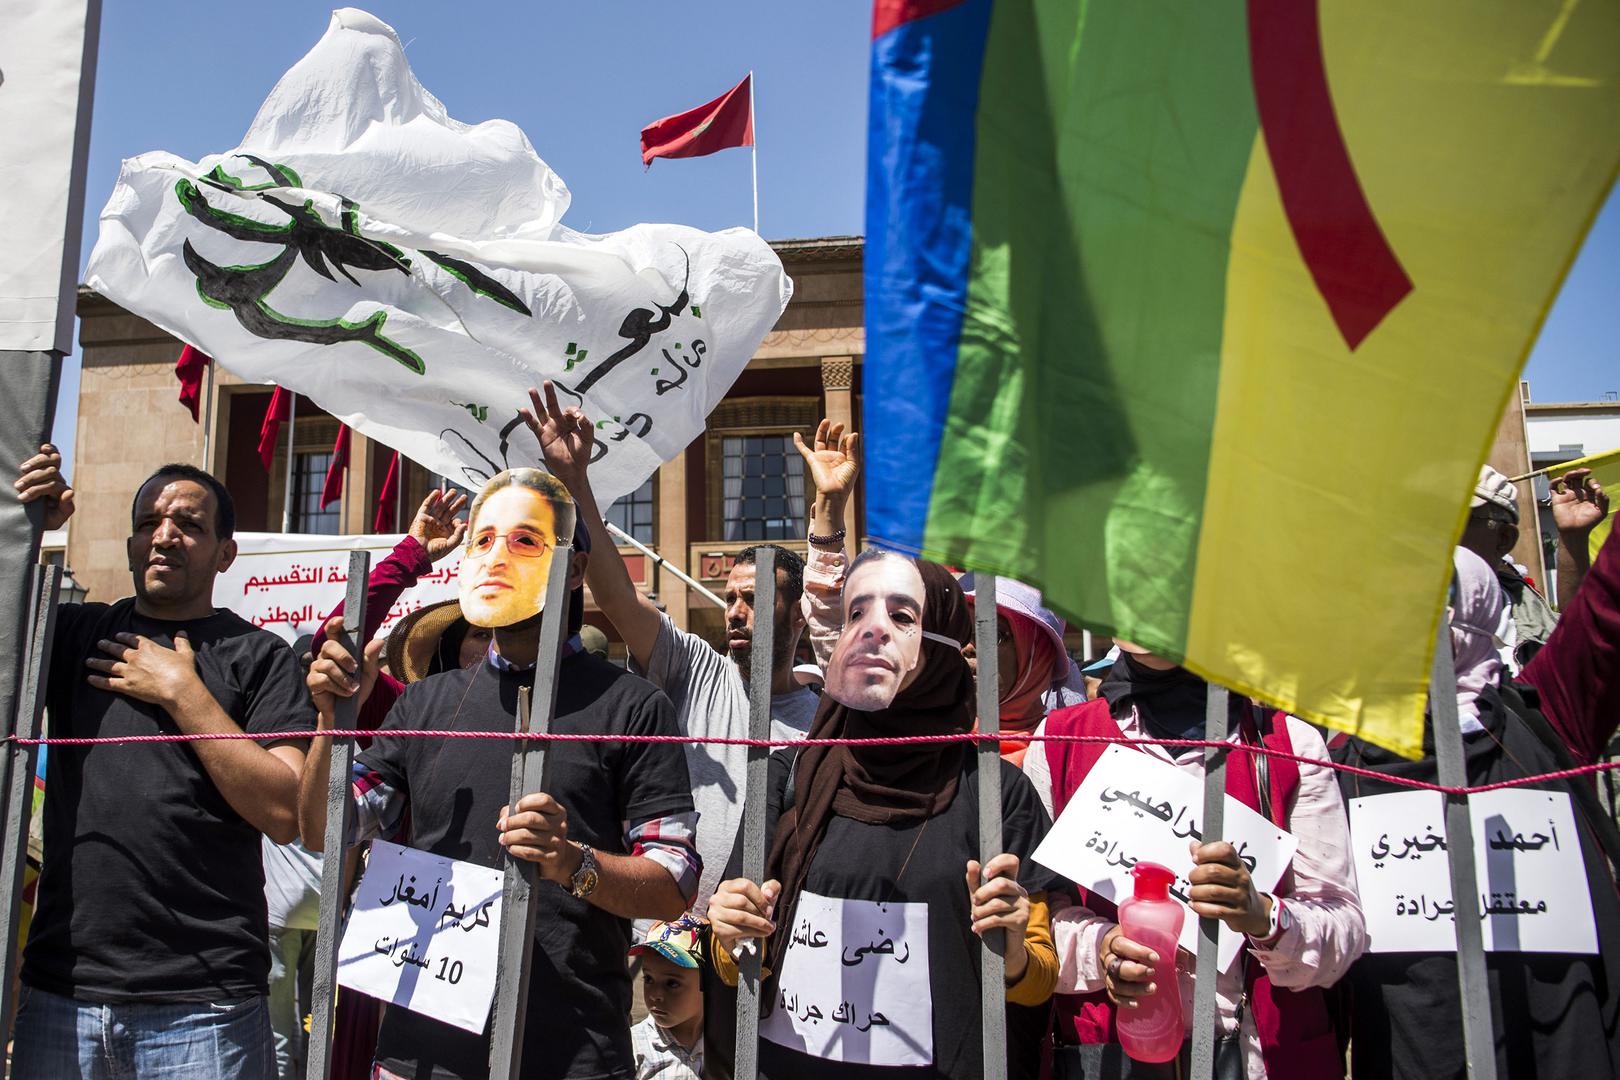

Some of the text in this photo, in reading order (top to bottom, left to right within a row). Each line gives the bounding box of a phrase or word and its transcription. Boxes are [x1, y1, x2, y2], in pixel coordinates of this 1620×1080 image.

[244, 564, 324, 595] التقسيم
[1489, 817, 1561, 853] أحمد
[379, 873, 494, 932] كريم أمغار
[1479, 892, 1548, 921] معتقل
[374, 936, 463, 985] 10 سنوات
[780, 988, 890, 1032] حراك جرادة
